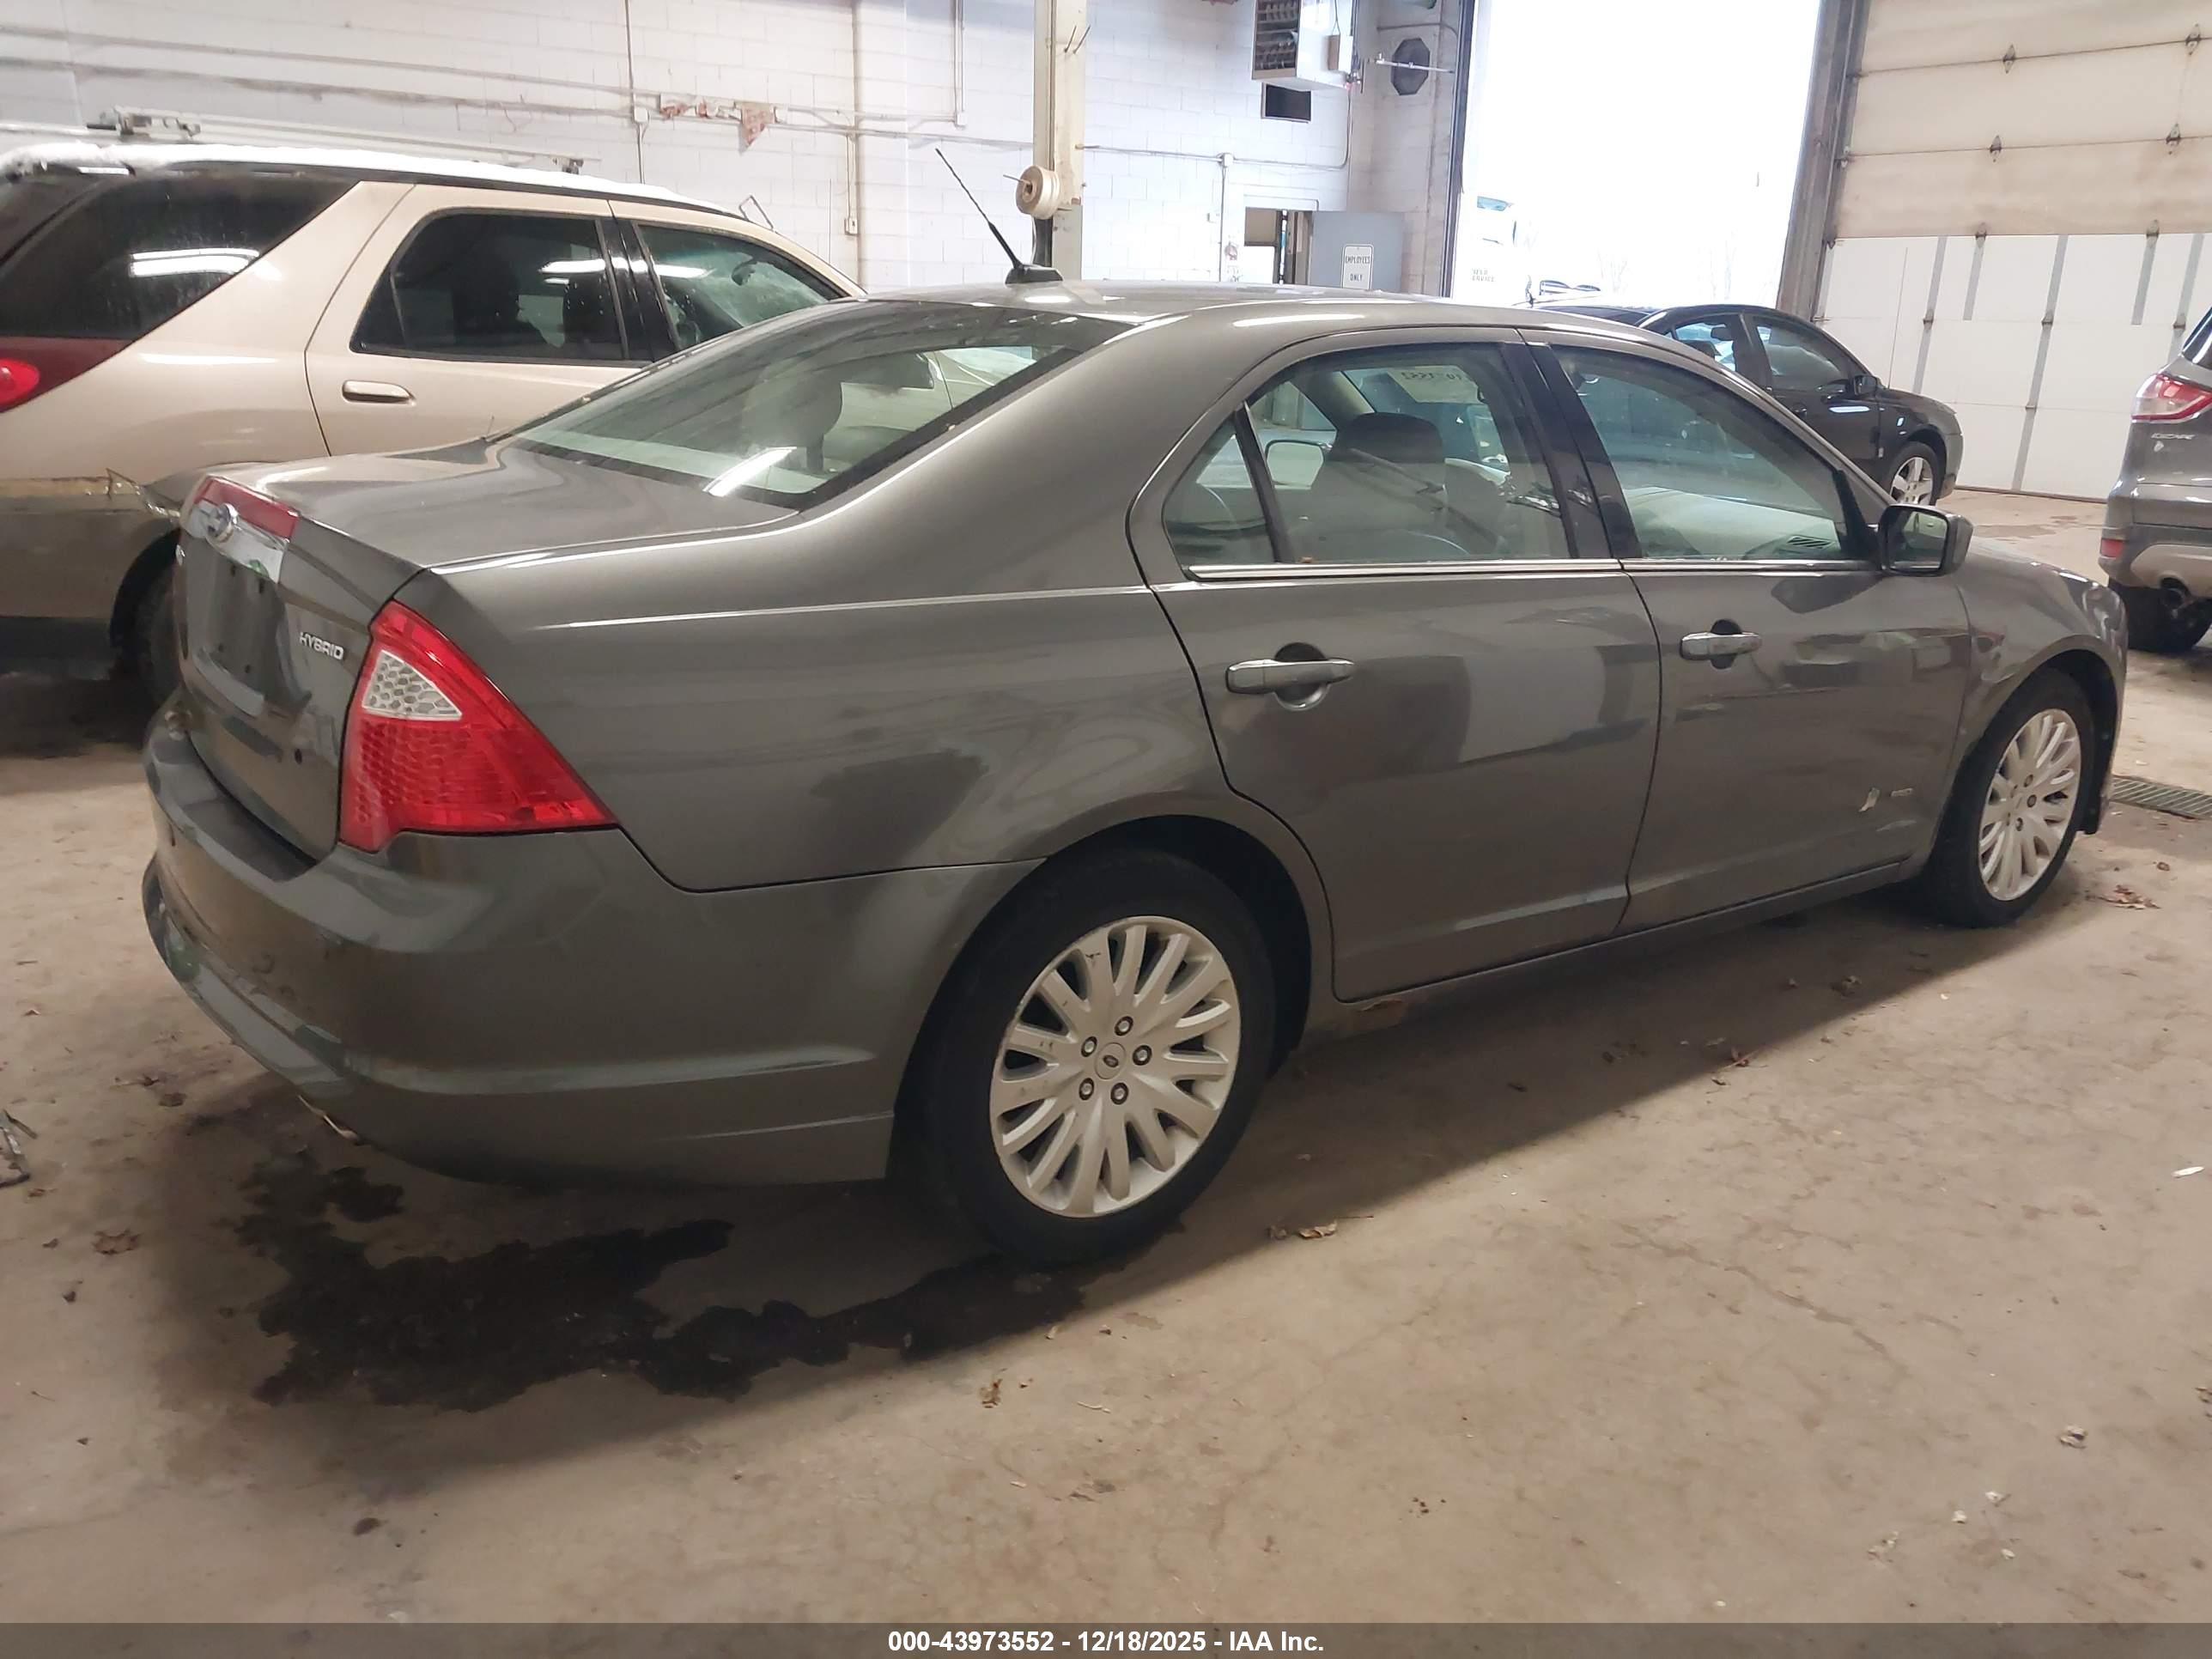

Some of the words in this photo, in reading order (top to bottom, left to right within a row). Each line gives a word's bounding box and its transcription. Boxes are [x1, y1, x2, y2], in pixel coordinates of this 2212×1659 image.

[1345, 256, 1370, 264] EMPLOYEES
[1350, 273, 1363, 282] ONLY
[300, 632, 343, 660] HYBRID
